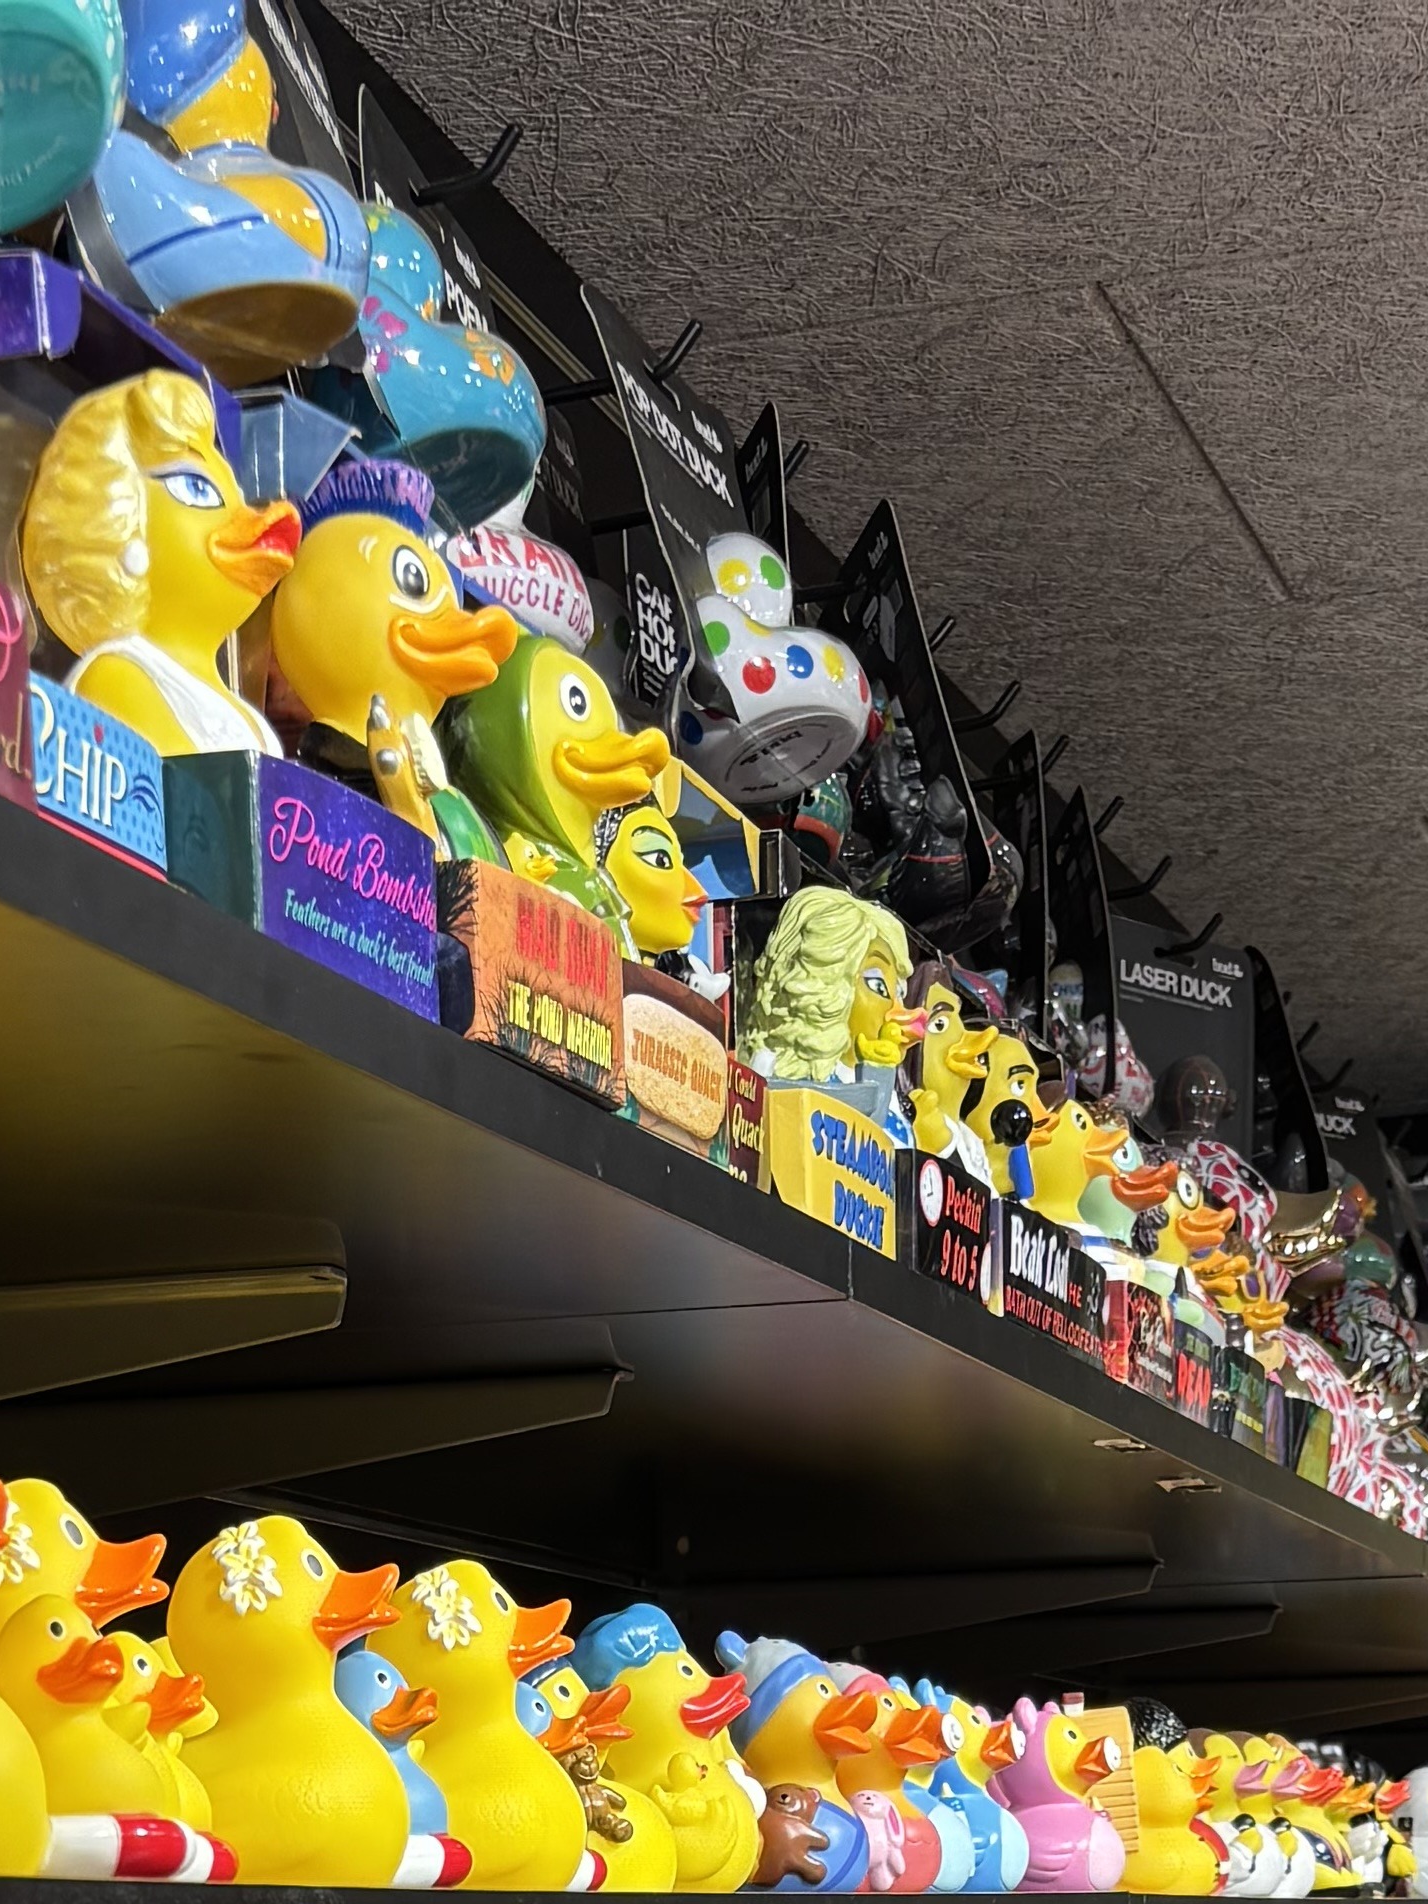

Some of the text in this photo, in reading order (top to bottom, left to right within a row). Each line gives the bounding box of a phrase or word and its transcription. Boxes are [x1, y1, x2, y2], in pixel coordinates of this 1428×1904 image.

[617, 361, 734, 508] POP DOT DUCK
[270, 797, 437, 933] Pond Bombshe
[284, 888, 331, 933] Feathers
[332, 920, 348, 945] are
[349, 931, 357, 949] a
[357, 929, 385, 968] duck's
[387, 938, 407, 976] best
[1120, 958, 1179, 996] LASER
[1180, 973, 1232, 1008] DUCK
[508, 980, 612, 1070] THE POND WARRIOR
[632, 1028, 723, 1106] JURASSIC QUACK
[734, 1068, 757, 1103] Could
[732, 1103, 765, 1155] Quack
[833, 1179, 885, 1251] DUCKIE
[946, 1174, 985, 1235] Peckin'
[940, 1229, 979, 1292] 9 to 5
[1009, 1213, 1046, 1289] Beak
[1026, 1295, 1043, 1328] OUT
[1042, 1306, 1052, 1332] OF
[1067, 1281, 1083, 1308] HE
